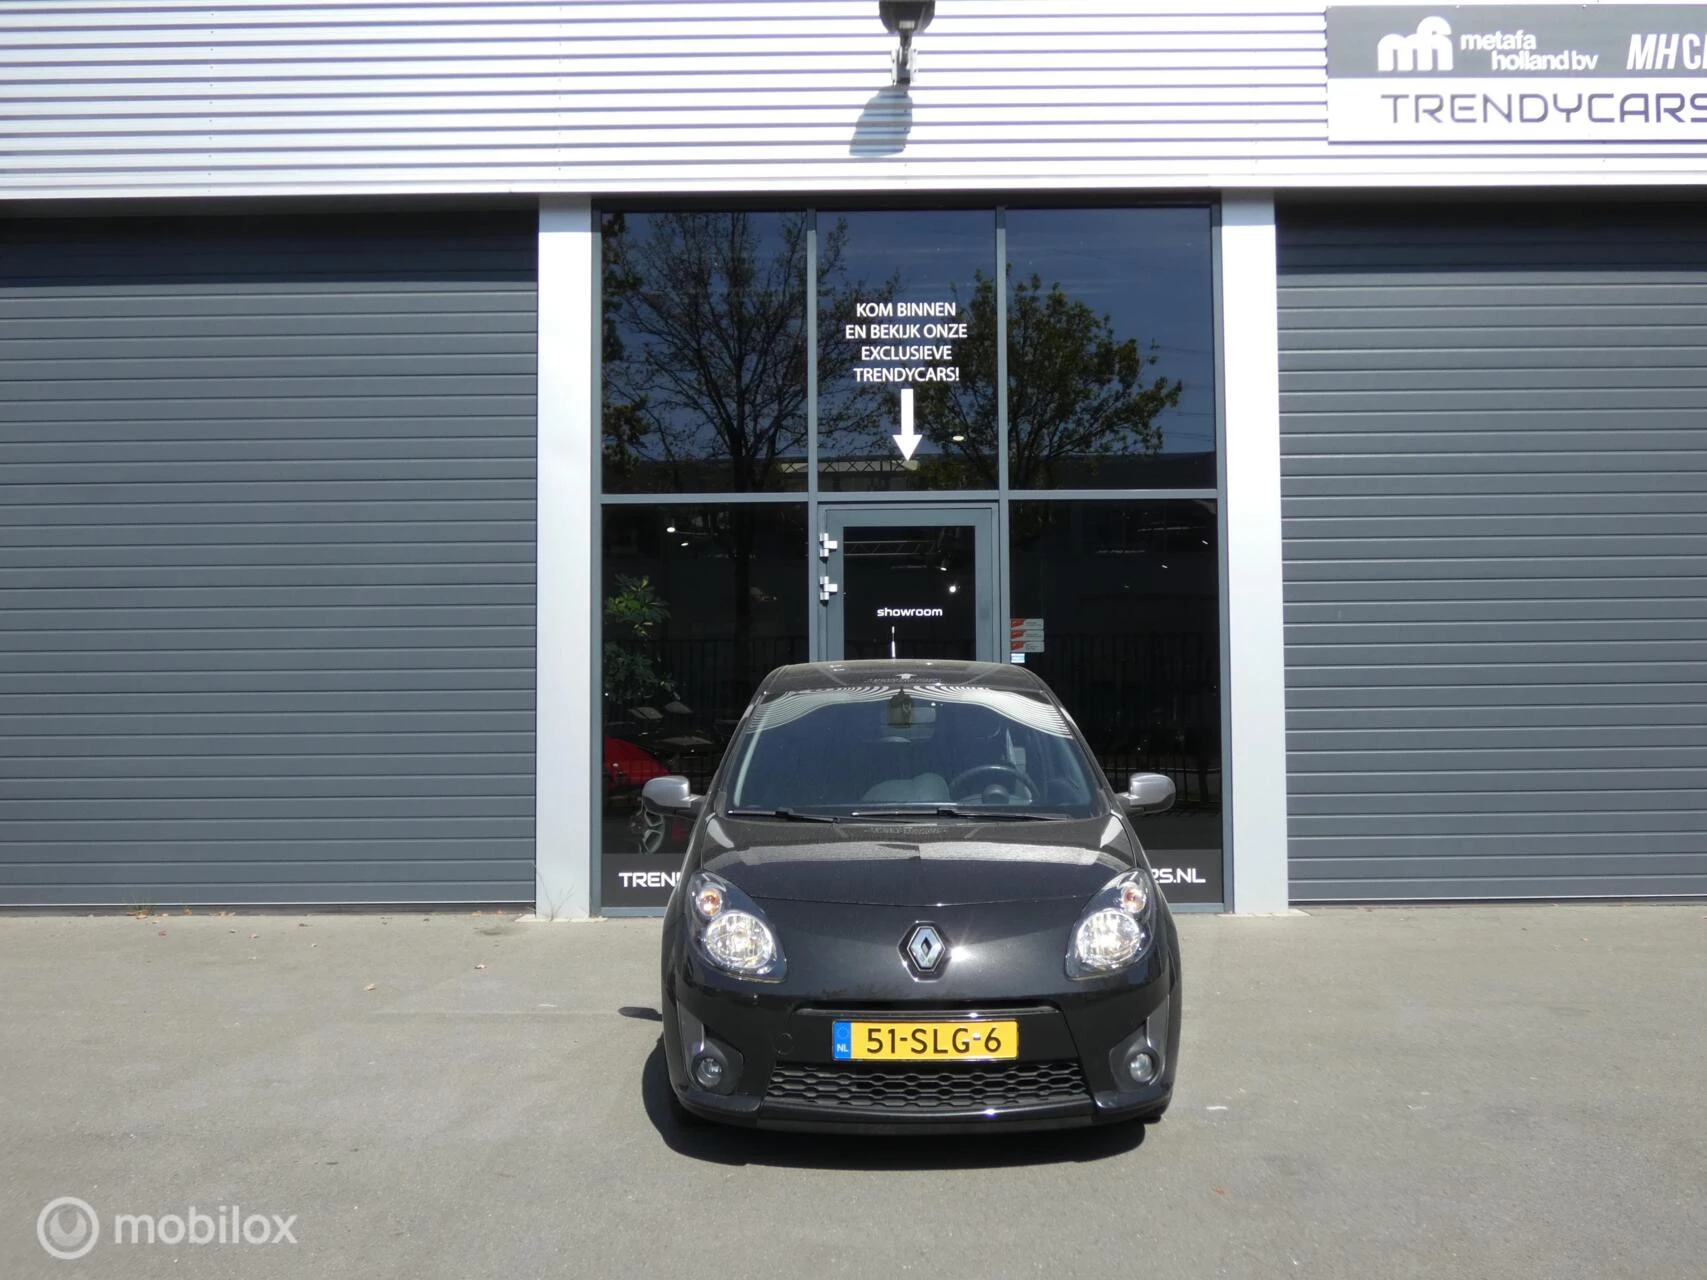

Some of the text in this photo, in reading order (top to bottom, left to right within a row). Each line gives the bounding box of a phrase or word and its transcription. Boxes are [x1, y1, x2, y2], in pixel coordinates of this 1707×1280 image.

[1460, 30, 1537, 50] metafa
[1626, 33, 1707, 70] MHC
[1381, 93, 1707, 123] TRENDYCARS
[856, 302, 956, 317] KOM BINNEN
[845, 323, 968, 339] EN BEKIJK ONZE
[861, 345, 952, 360] EXCLUSIEVE
[853, 366, 960, 382] TRENDYCARS!
[877, 607, 943, 617] showroom
[836, 1044, 849, 1053] NL
[866, 1028, 1001, 1054] 51-SLG-6
